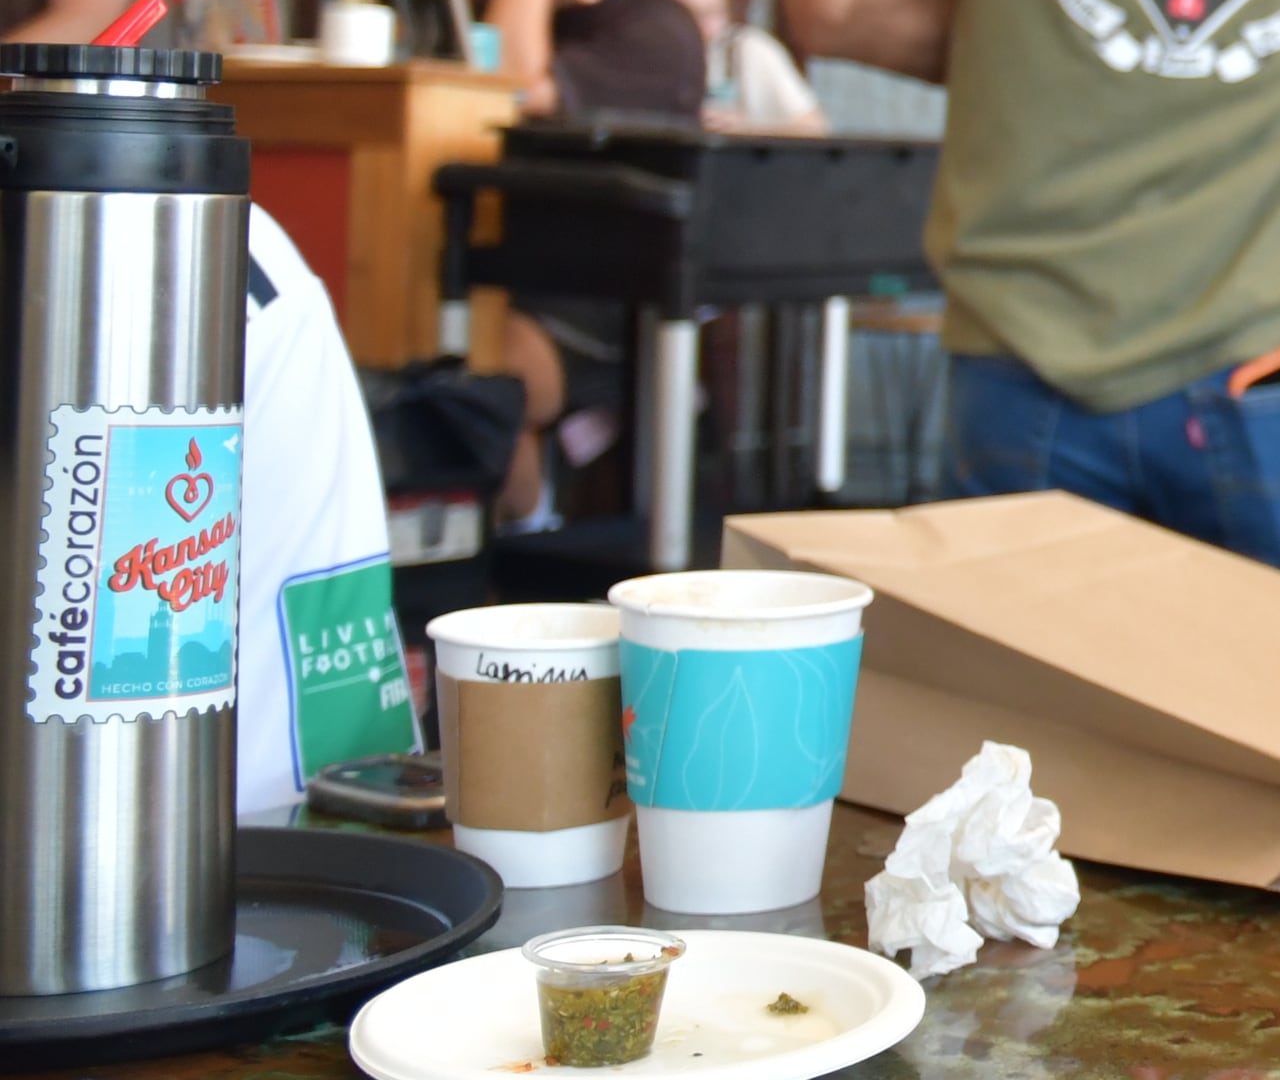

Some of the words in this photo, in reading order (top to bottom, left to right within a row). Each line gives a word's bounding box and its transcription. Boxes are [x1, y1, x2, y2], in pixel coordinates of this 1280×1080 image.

[48, 433, 104, 700] cafécorazón
[108, 511, 236, 593] Kansas
[157, 559, 230, 613] City
[101, 681, 153, 695] HECHO
